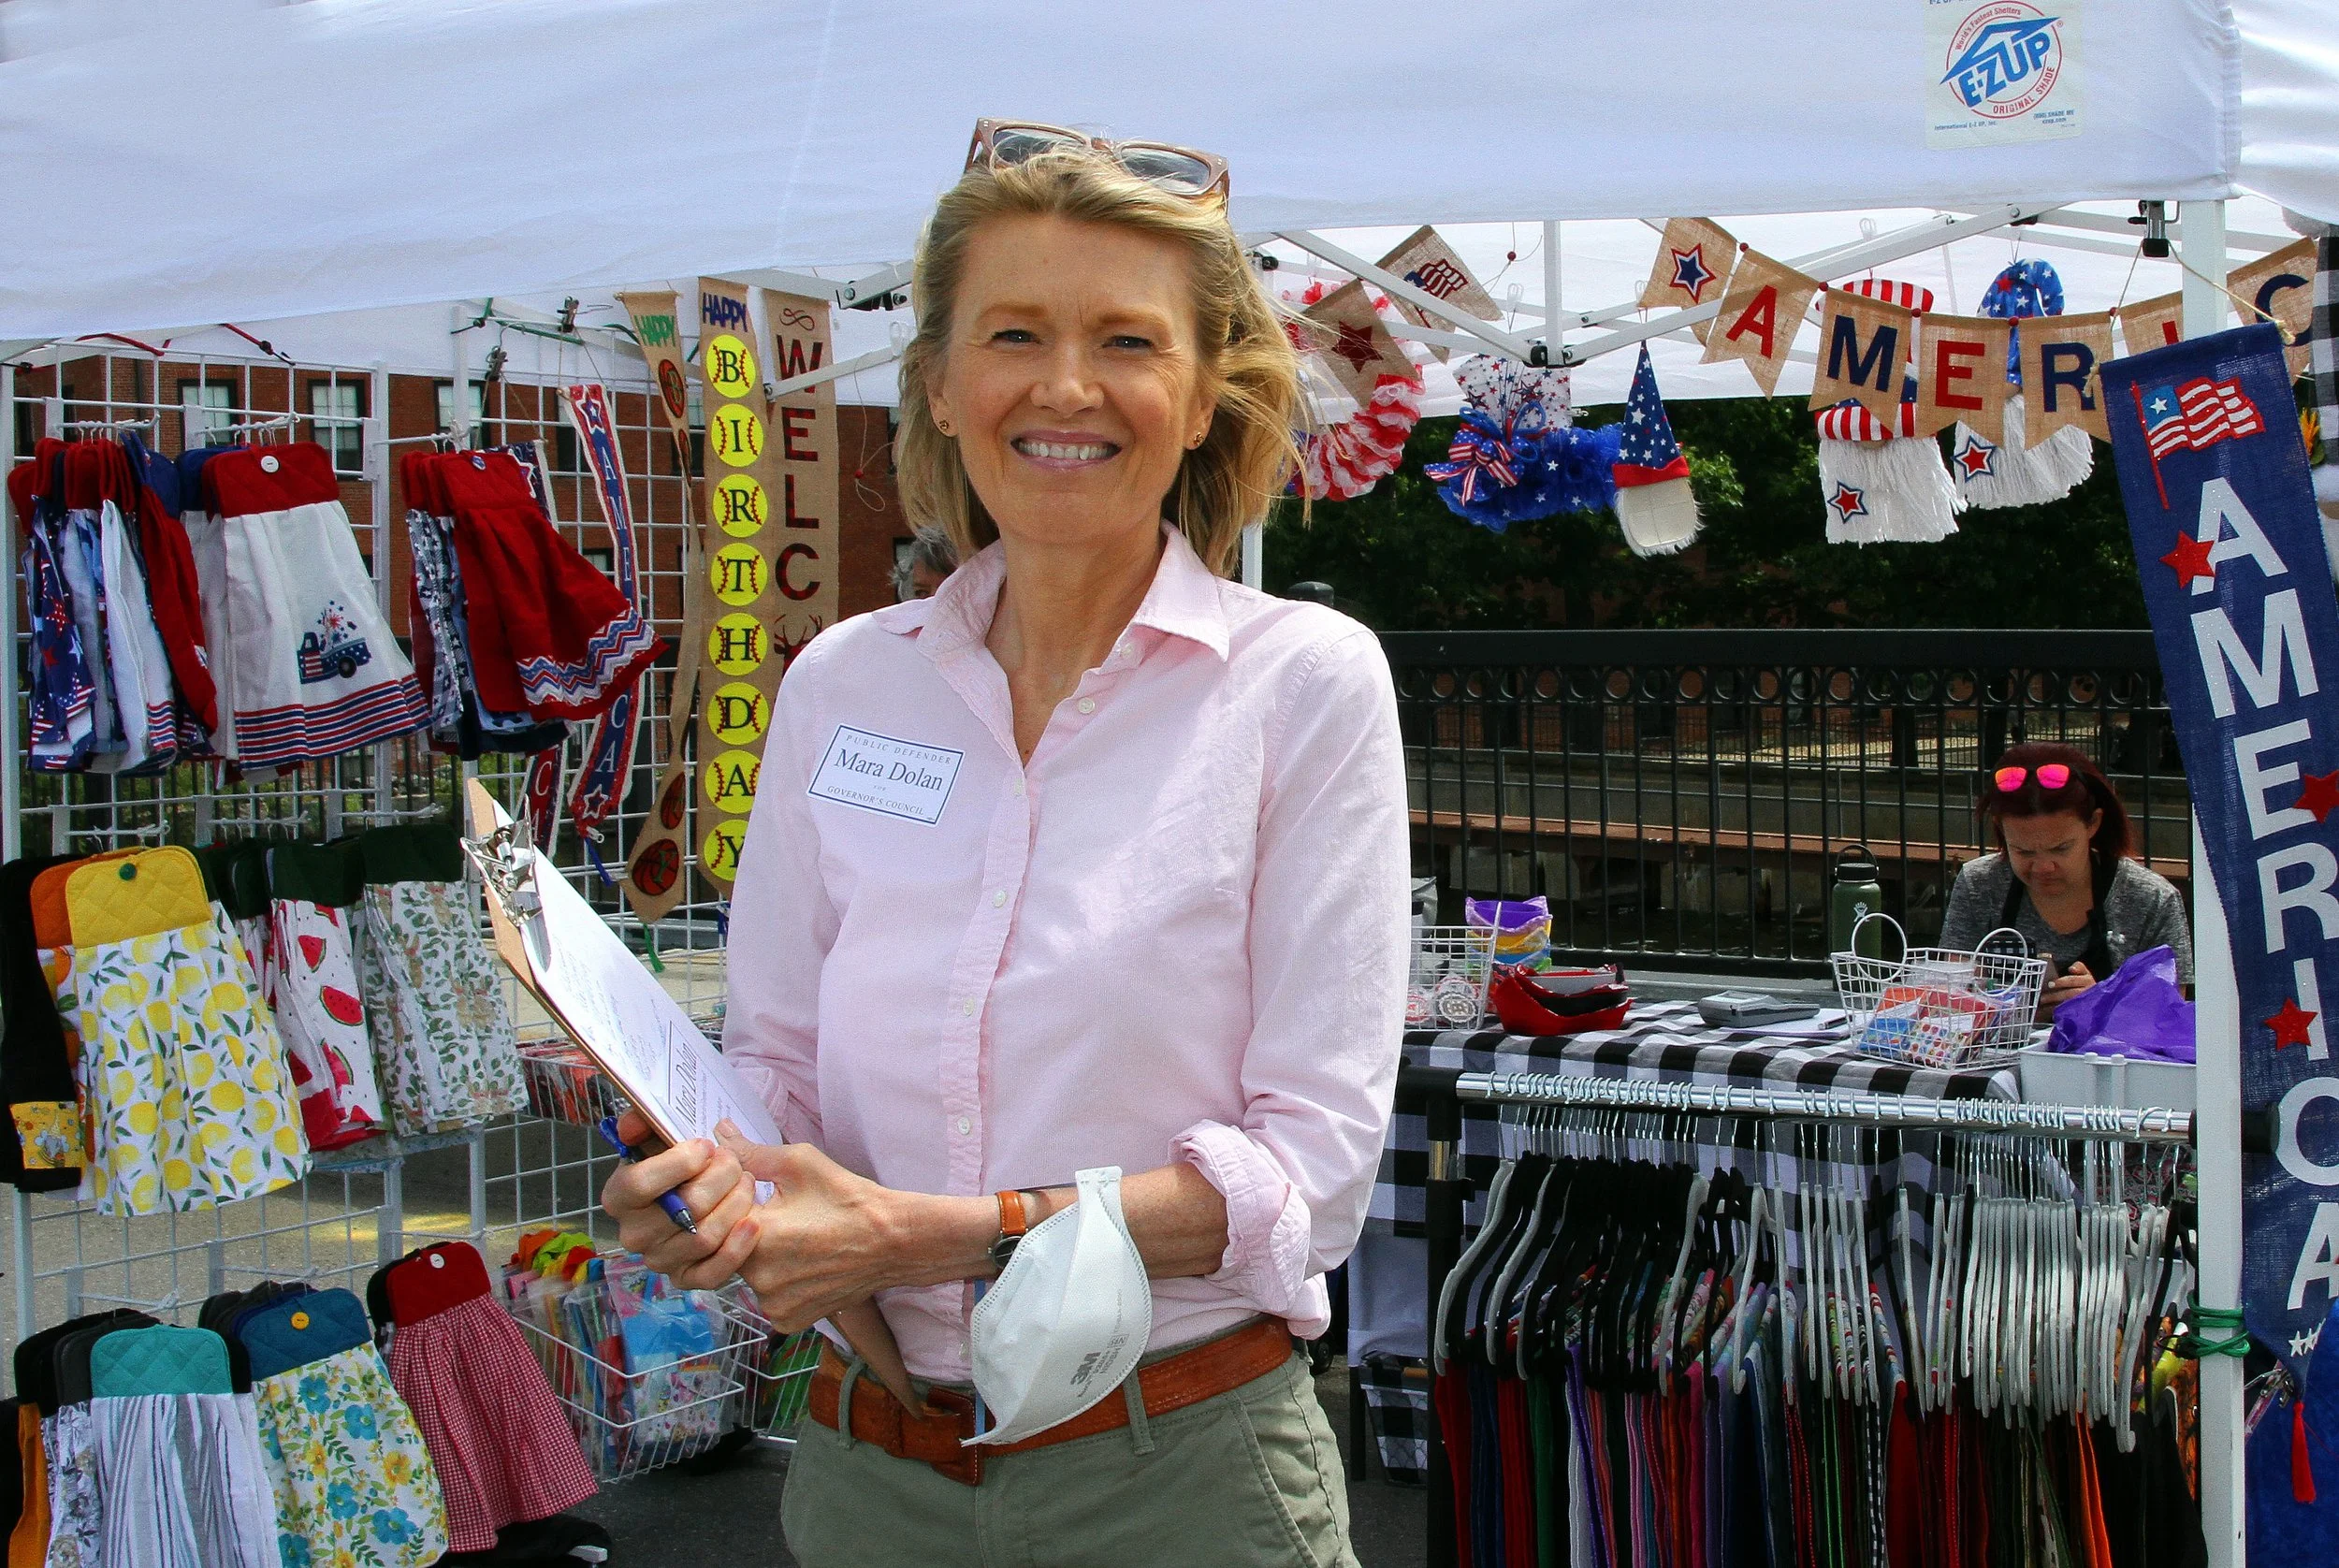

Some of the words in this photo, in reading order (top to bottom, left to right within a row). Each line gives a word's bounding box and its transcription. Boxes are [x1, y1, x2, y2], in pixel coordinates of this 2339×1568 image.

[1954, 27, 1972, 51] World's
[1969, 10, 1993, 28] Fastest
[1994, 7, 2022, 17] Shelters
[1993, 96, 2035, 114] ORIGINAL
[2035, 65, 2056, 95] SHADE
[1934, 122, 1968, 131] International
[633, 313, 676, 348] HAPPY
[702, 292, 748, 333] HAPPY
[719, 349, 756, 869] BIRTHDAY
[834, 748, 884, 778] Mara
[887, 761, 943, 791] Dolan
[846, 733, 889, 752] PUBLIC
[893, 746, 952, 765] DEFENDER
[827, 784, 884, 806] GOVERNOR'S
[884, 799, 925, 816] COUNCIL
[675, 1041, 698, 1094] Dolan
[675, 1085, 697, 1134] Mara
[1069, 1351, 1102, 1386] 3M
